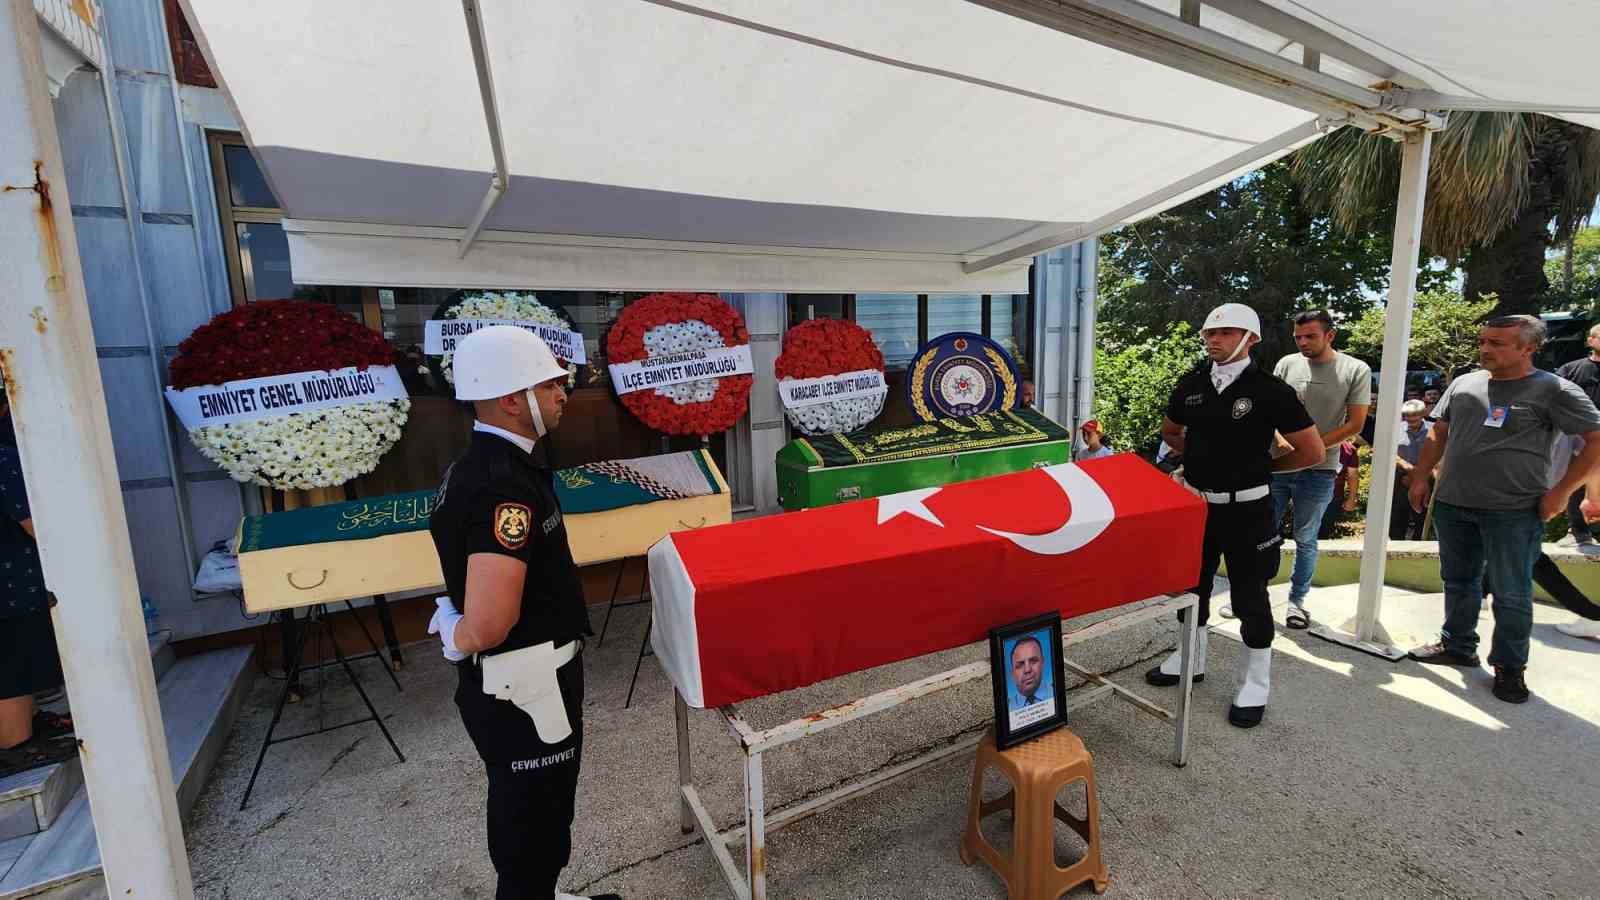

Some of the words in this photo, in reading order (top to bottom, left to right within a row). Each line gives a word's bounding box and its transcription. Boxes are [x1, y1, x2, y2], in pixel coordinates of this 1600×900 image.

[441, 322, 473, 337] BURSA
[622, 373, 644, 391] İLÇE
[644, 366, 683, 385] EMNİYET
[684, 355, 737, 378] MÜDÜRLÜĞÜ
[198, 386, 257, 418] EMNİYET
[259, 382, 303, 410] GENEL
[302, 370, 375, 403] MÜDÜRLÜĞÜ
[790, 383, 821, 401] KARACABEY
[541, 747, 576, 767] KUVVET
